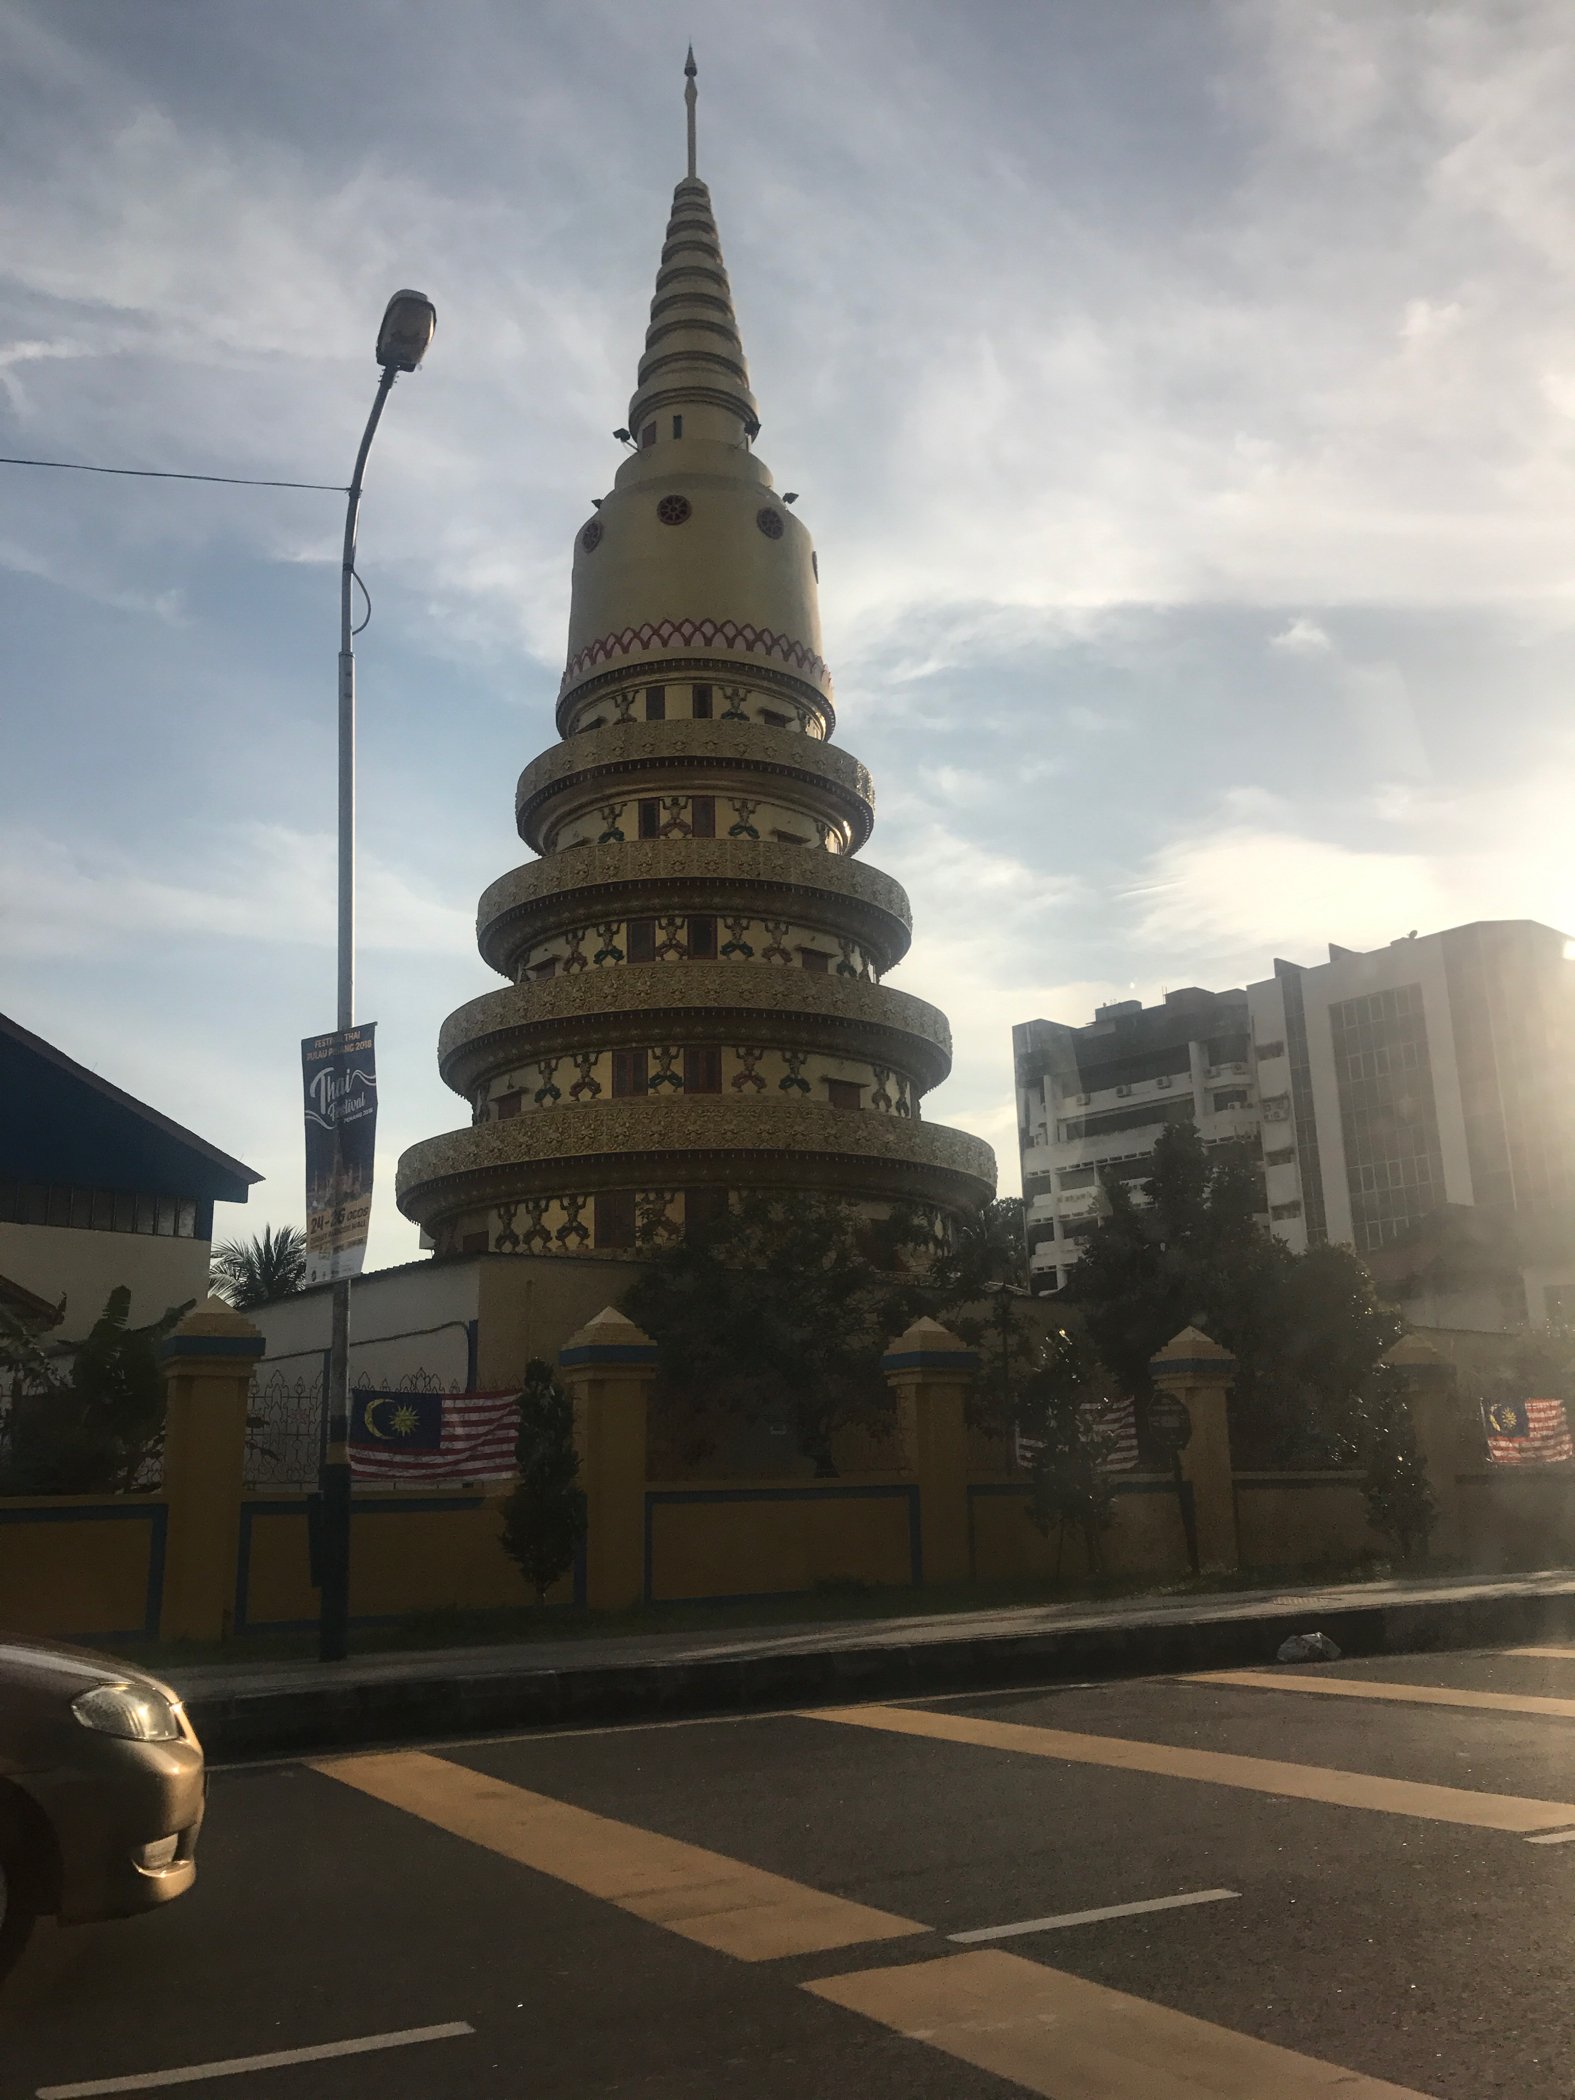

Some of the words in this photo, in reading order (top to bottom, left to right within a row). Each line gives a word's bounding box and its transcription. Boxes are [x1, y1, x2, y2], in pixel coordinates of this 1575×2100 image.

[344, 1031, 360, 1042] THAI
[329, 1043, 354, 1056] PNG
[310, 1066, 351, 1115] Thai
[327, 1091, 365, 1121] Ftival
